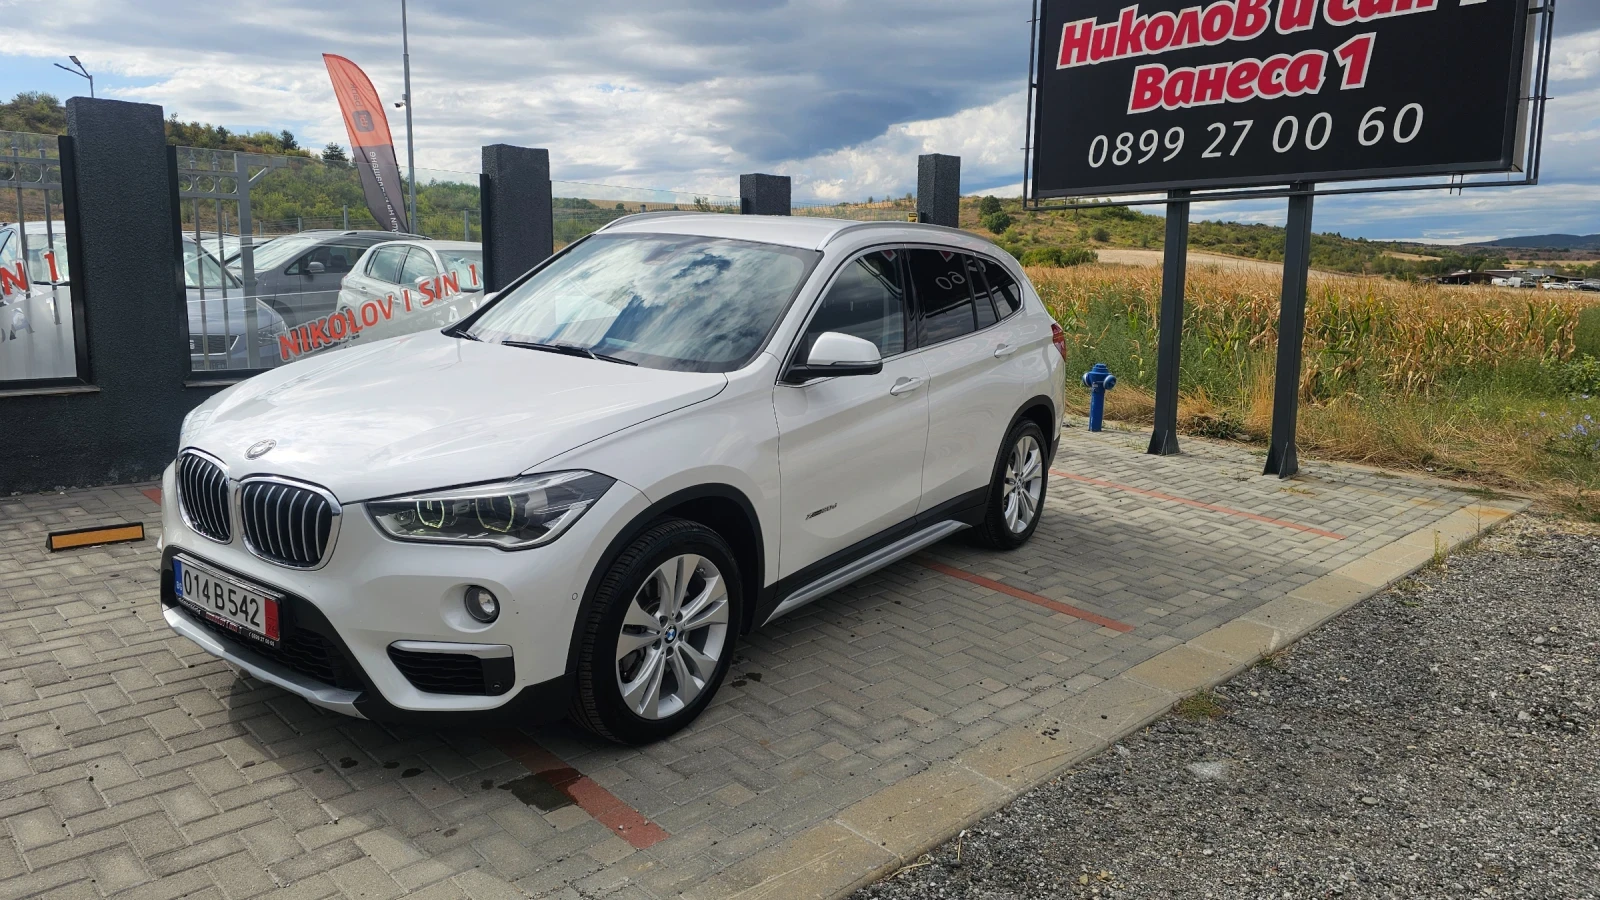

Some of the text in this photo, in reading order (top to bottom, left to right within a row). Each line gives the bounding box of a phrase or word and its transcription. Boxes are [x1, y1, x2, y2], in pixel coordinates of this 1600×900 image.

[1056, 0, 1271, 70] Николов
[1127, 32, 1377, 114] Ванеса 1
[1088, 102, 1424, 168] 0899 27 00 60
[44, 252, 59, 281] 1
[277, 262, 479, 361] NIKOLOV I SIN 1
[184, 569, 260, 628] 014B542
